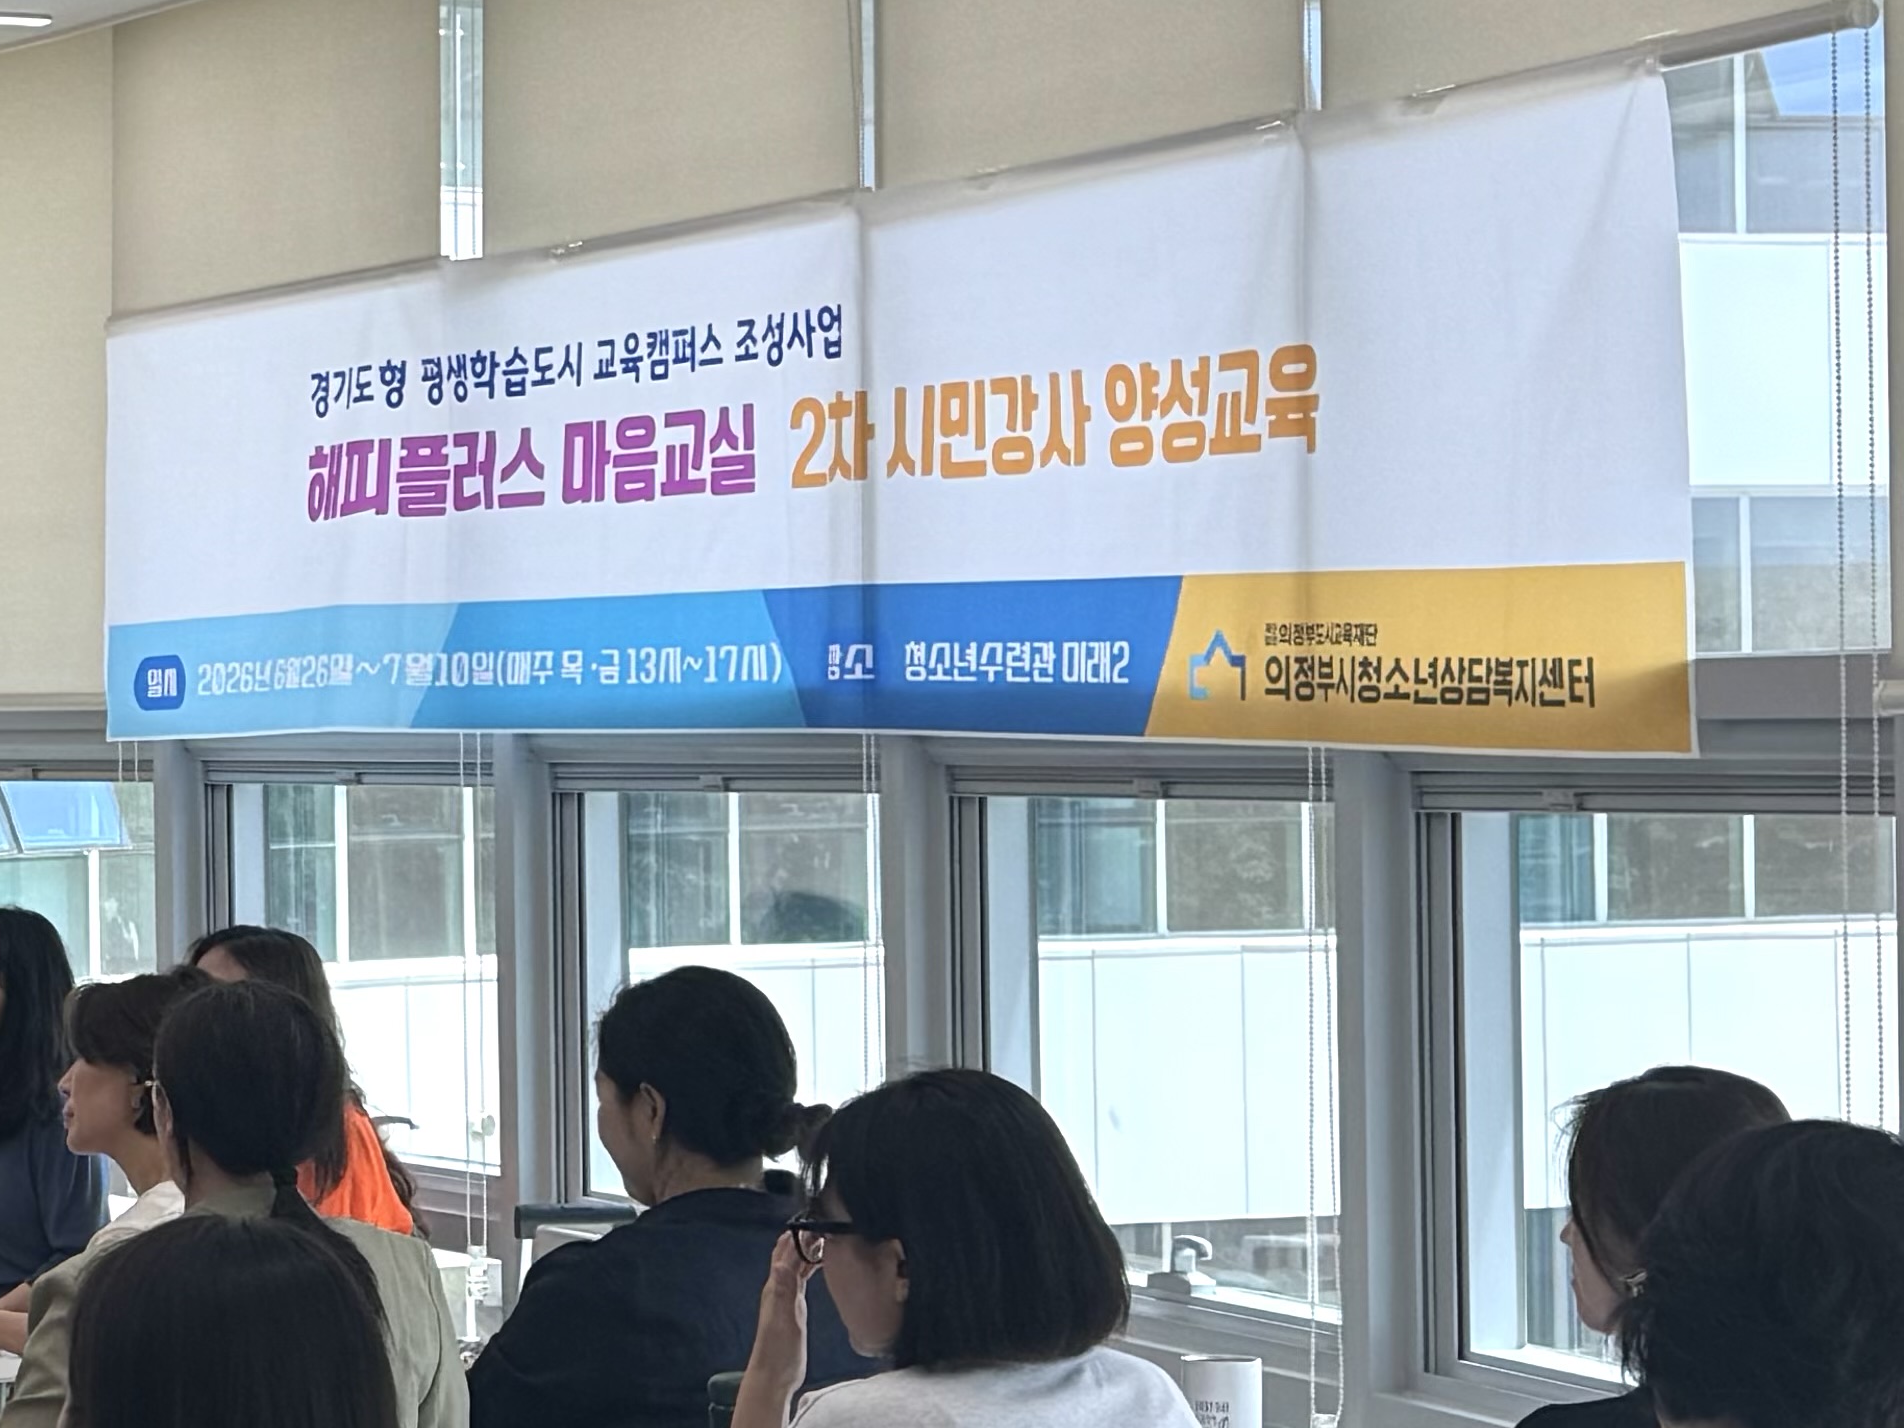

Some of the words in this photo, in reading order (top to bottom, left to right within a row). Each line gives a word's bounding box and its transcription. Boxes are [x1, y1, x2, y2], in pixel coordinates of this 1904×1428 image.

[310, 358, 406, 419] 경기도형
[420, 341, 584, 407] 평생학습도시
[593, 323, 724, 383] 교육캠퍼스
[734, 303, 843, 369] 조성사업
[306, 426, 546, 523] 해피플러스
[561, 402, 757, 505] 마음교실
[790, 390, 875, 489] 2차
[886, 369, 1092, 479] 시민강사
[1104, 343, 1320, 467] 양성교육
[146, 667, 177, 698] 일시
[905, 640, 1056, 683] 청소년수련관
[1062, 640, 1130, 684] 미래2
[1264, 655, 1596, 709] 의정부시청소년상담복지센터
